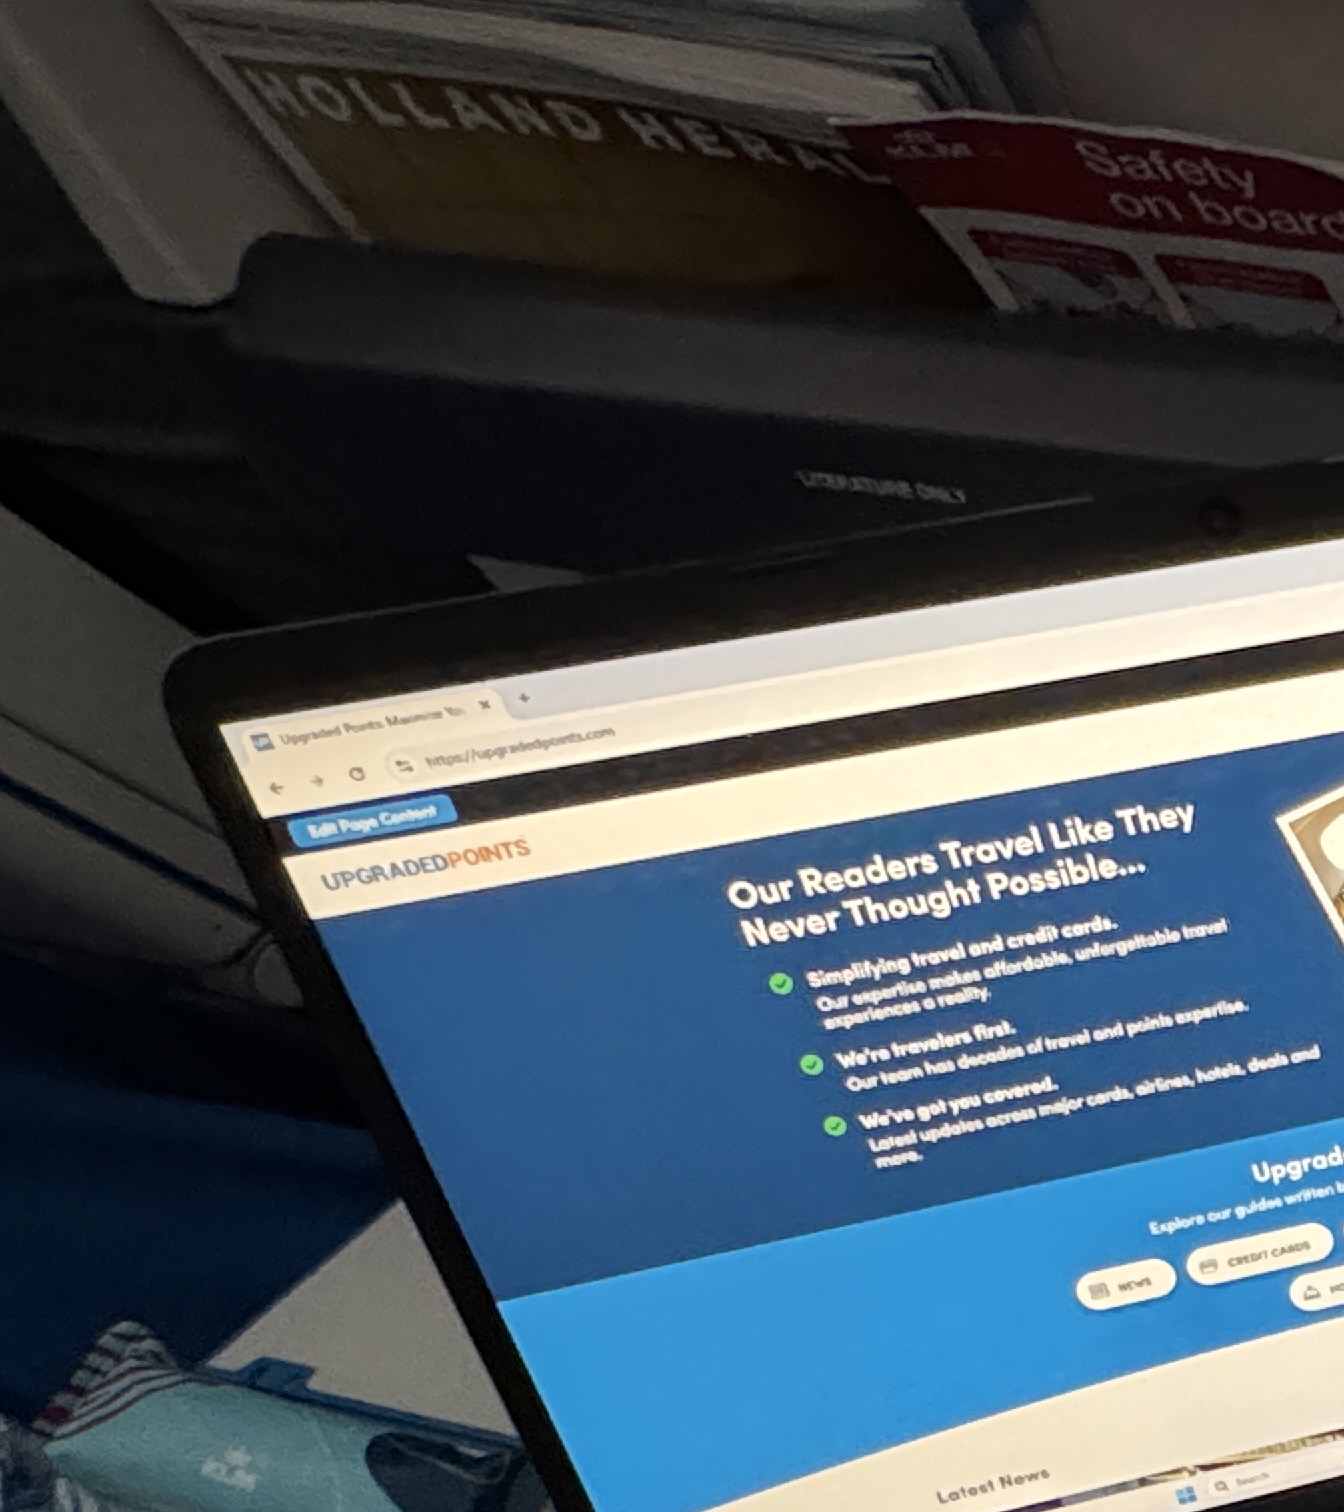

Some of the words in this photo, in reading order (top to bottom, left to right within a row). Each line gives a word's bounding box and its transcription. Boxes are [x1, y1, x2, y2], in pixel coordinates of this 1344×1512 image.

[245, 67, 603, 143] HOLLAND
[616, 106, 893, 186] HERAL
[1075, 138, 1258, 200] Safety
[1109, 189, 1185, 223] on
[791, 468, 914, 500] LITERATURE
[913, 480, 967, 505] ONLY
[278, 725, 342, 746] Upgraded
[306, 821, 337, 840] Edit
[340, 814, 379, 836] Page
[380, 803, 438, 827] Content
[320, 837, 532, 892] UPGRADEDPOINTS
[727, 877, 794, 911] Our
[798, 850, 939, 897] Readers
[938, 826, 1045, 872] Travel
[1047, 815, 1114, 850] Like
[1115, 803, 1196, 837] They
[739, 907, 840, 948] Never
[842, 881, 982, 927] Thought
[985, 853, 1147, 901] Possible...
[805, 956, 911, 989] Simplifying
[911, 943, 966, 968] travel
[968, 934, 1004, 957] and
[1006, 924, 1060, 951] credit
[1061, 916, 1119, 939] cards.
[815, 993, 850, 1012] Our
[851, 979, 927, 1006] expertise
[928, 969, 982, 991] makes
[983, 952, 1073, 980] affordable,
[1074, 928, 1182, 962] unforgettable
[1182, 919, 1229, 941] travel
[823, 998, 922, 1031] experiences
[923, 997, 937, 1012] a
[938, 985, 990, 1009] reality.
[835, 1046, 891, 1070] We're
[891, 1028, 973, 1058] travelers
[973, 1020, 1017, 1041] first.
[845, 1073, 878, 1092] Our
[879, 1064, 925, 1086] team
[925, 1057, 956, 1077] has
[956, 1044, 1025, 1070] decades
[1025, 1036, 1044, 1055] of
[1045, 1028, 1091, 1051] travel
[1092, 1021, 1125, 1042] and
[1126, 1013, 1174, 1038] points
[1174, 1000, 1250, 1030] expertise.
[858, 1106, 915, 1130] We've
[916, 1099, 948, 1121] got
[948, 1094, 983, 1116] you
[983, 1075, 1059, 1104] covered.
[868, 1129, 918, 1153] Latest
[919, 1116, 984, 1144] updates
[985, 1106, 1037, 1128] across
[1038, 1096, 1085, 1120] major
[1247, 1053, 1289, 1074] deals
[1290, 1045, 1321, 1065] and
[875, 1150, 924, 1170] more.
[1149, 1211, 1206, 1237] Explore
[1206, 1206, 1232, 1223] our
[1234, 1194, 1283, 1220] guides
[1284, 1185, 1335, 1207] written
[1226, 1250, 1269, 1269] CREDIT
[1270, 1240, 1312, 1259] CARDS
[1117, 1275, 1153, 1293] NEWS
[936, 1478, 996, 1506] Latest
[998, 1467, 1052, 1490] News
[1234, 1470, 1271, 1488] Search
